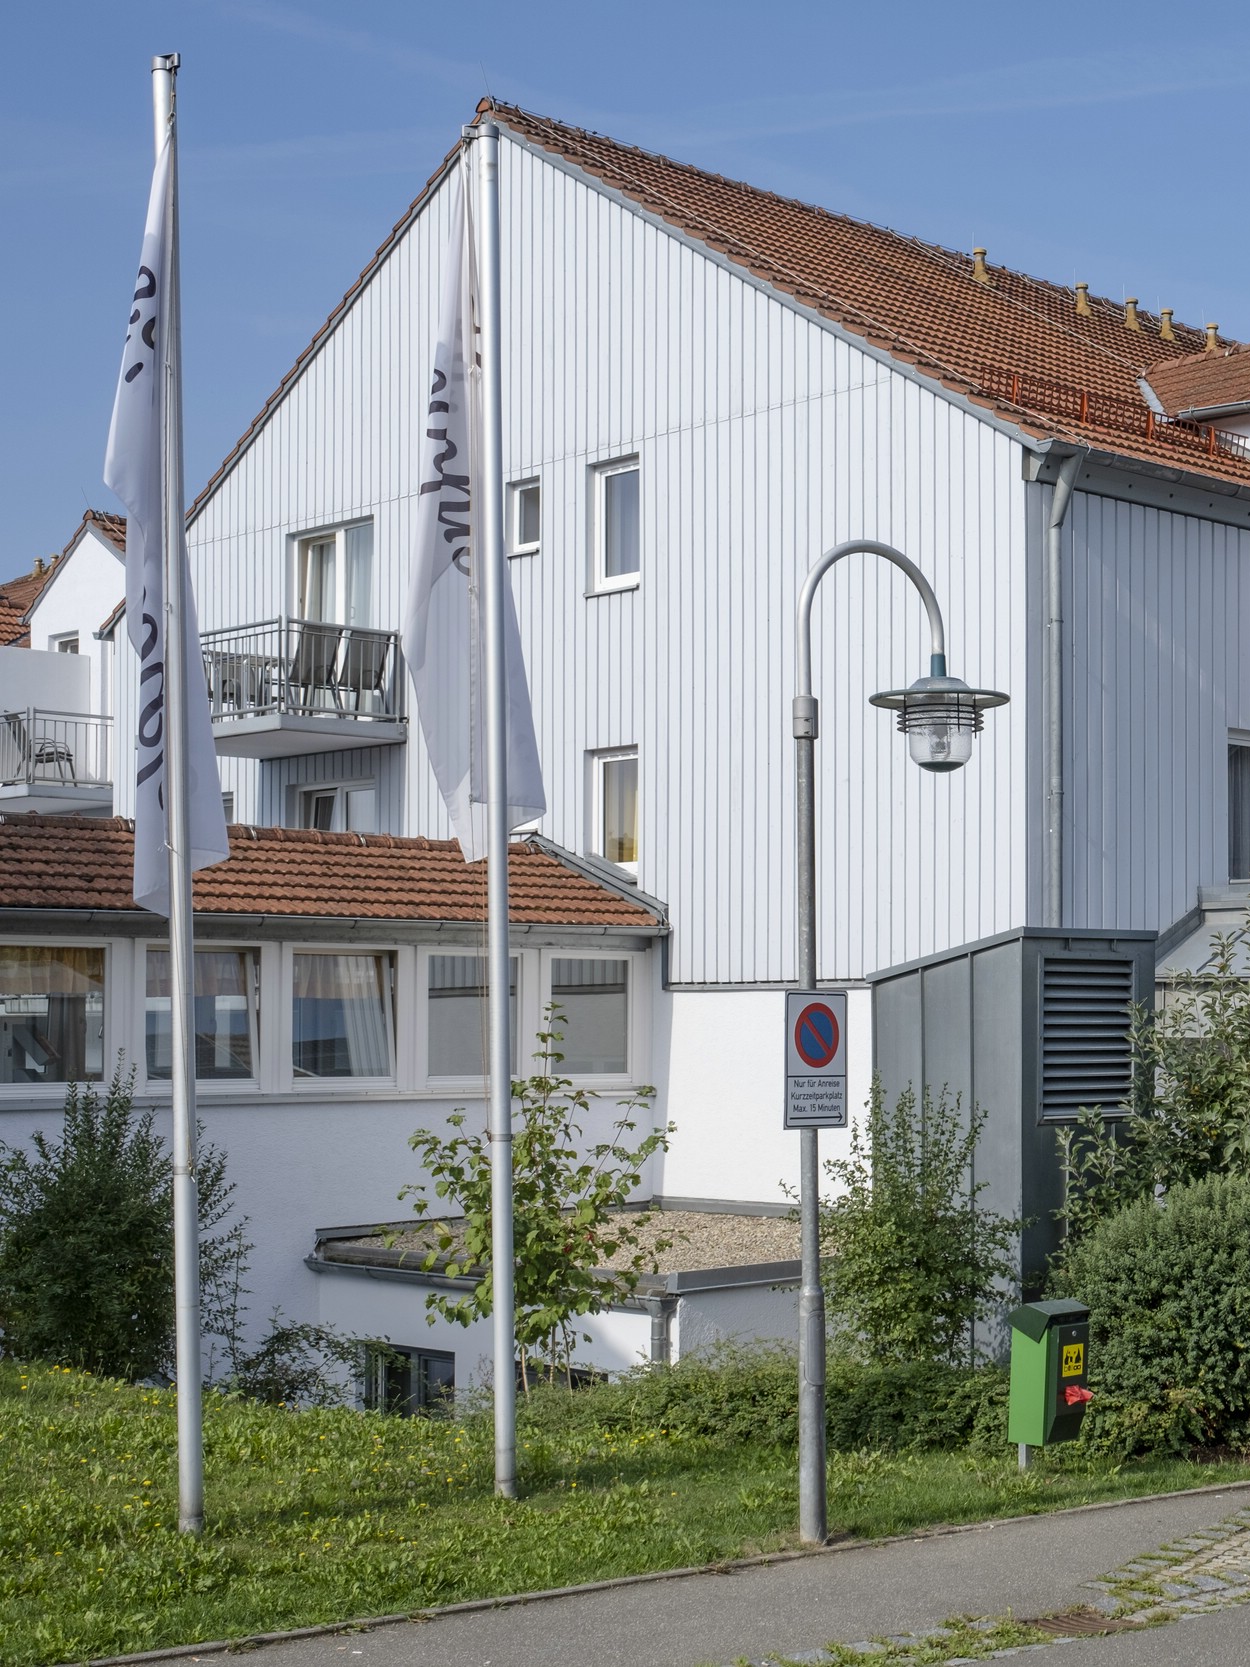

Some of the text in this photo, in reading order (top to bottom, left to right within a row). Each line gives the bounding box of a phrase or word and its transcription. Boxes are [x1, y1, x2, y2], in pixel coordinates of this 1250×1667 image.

[807, 1079, 816, 1087] für
[817, 1079, 840, 1087] Anreise
[790, 1091, 843, 1102] Kurzzeitparkplatz
[792, 1103, 841, 1113] Max. 15 Minuten
